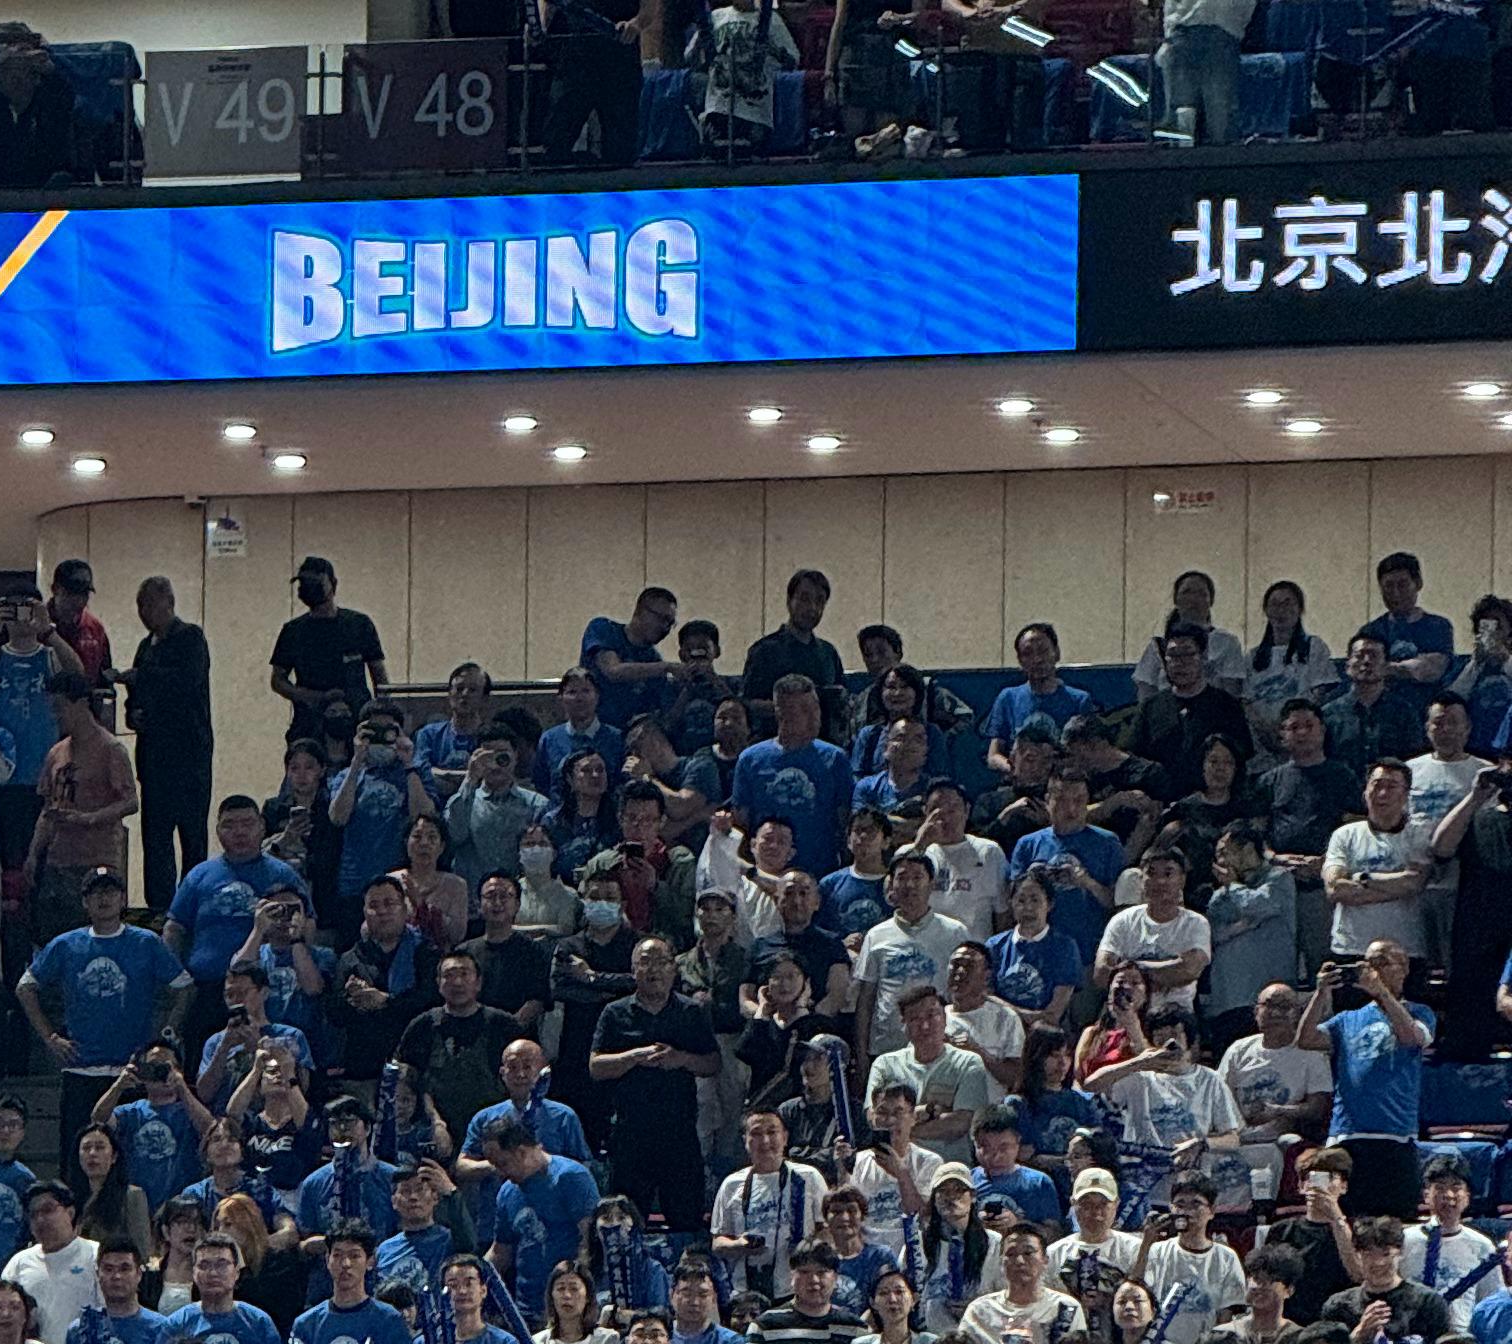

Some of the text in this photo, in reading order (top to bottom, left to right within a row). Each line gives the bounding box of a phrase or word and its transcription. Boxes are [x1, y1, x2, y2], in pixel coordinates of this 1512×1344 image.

[159, 76, 295, 146] V 49
[355, 70, 494, 139] V 48
[270, 220, 699, 354] BEIJING
